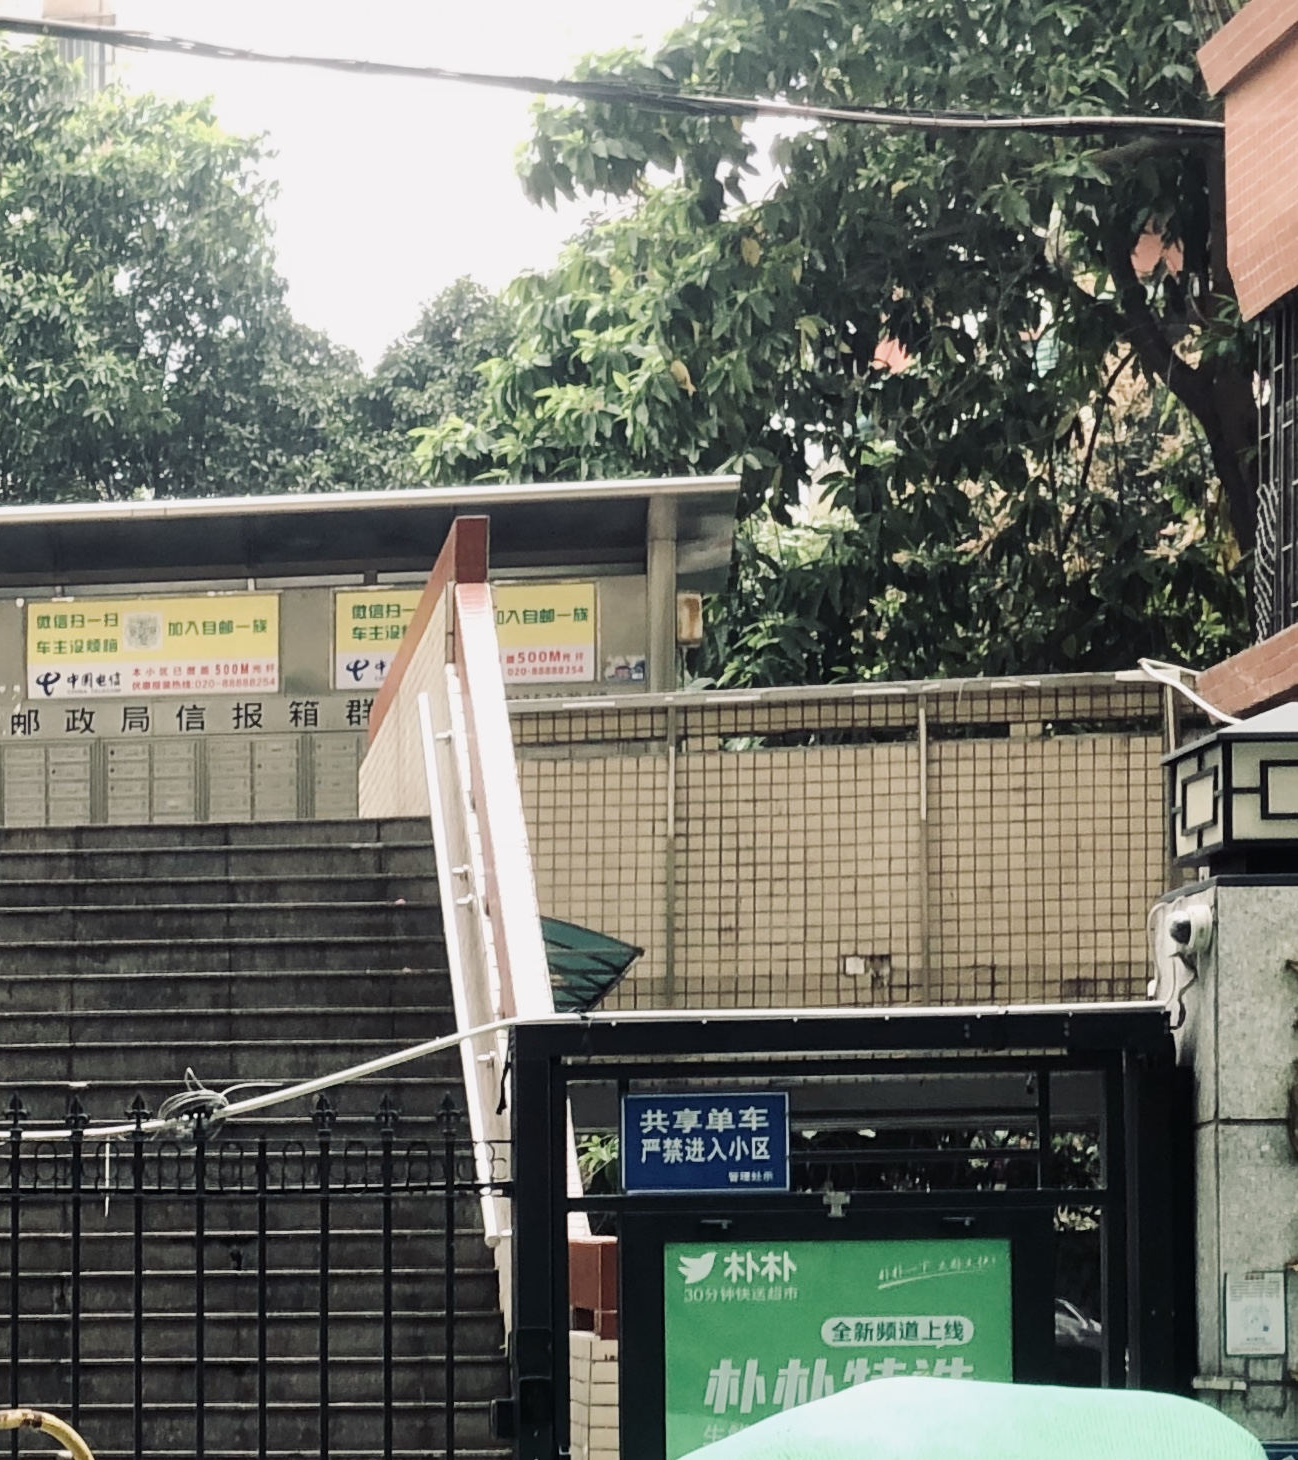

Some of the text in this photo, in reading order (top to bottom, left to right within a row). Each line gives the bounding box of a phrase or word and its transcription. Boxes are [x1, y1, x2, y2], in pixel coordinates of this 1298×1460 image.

[36, 611, 119, 631] 微信扫一扫
[167, 617, 269, 638] 加入自邮一族
[36, 637, 119, 655] 车主没烦恼
[66, 671, 122, 691] 中国电信
[507, 664, 585, 678] 020-88888254
[639, 1106, 770, 1134] 共享单车
[640, 1135, 772, 1166] 严禁进入小区
[723, 1250, 798, 1285] 朴朴
[683, 1285, 799, 1303] 30分钟快送超市
[831, 1320, 966, 1344] 全新频道上线
